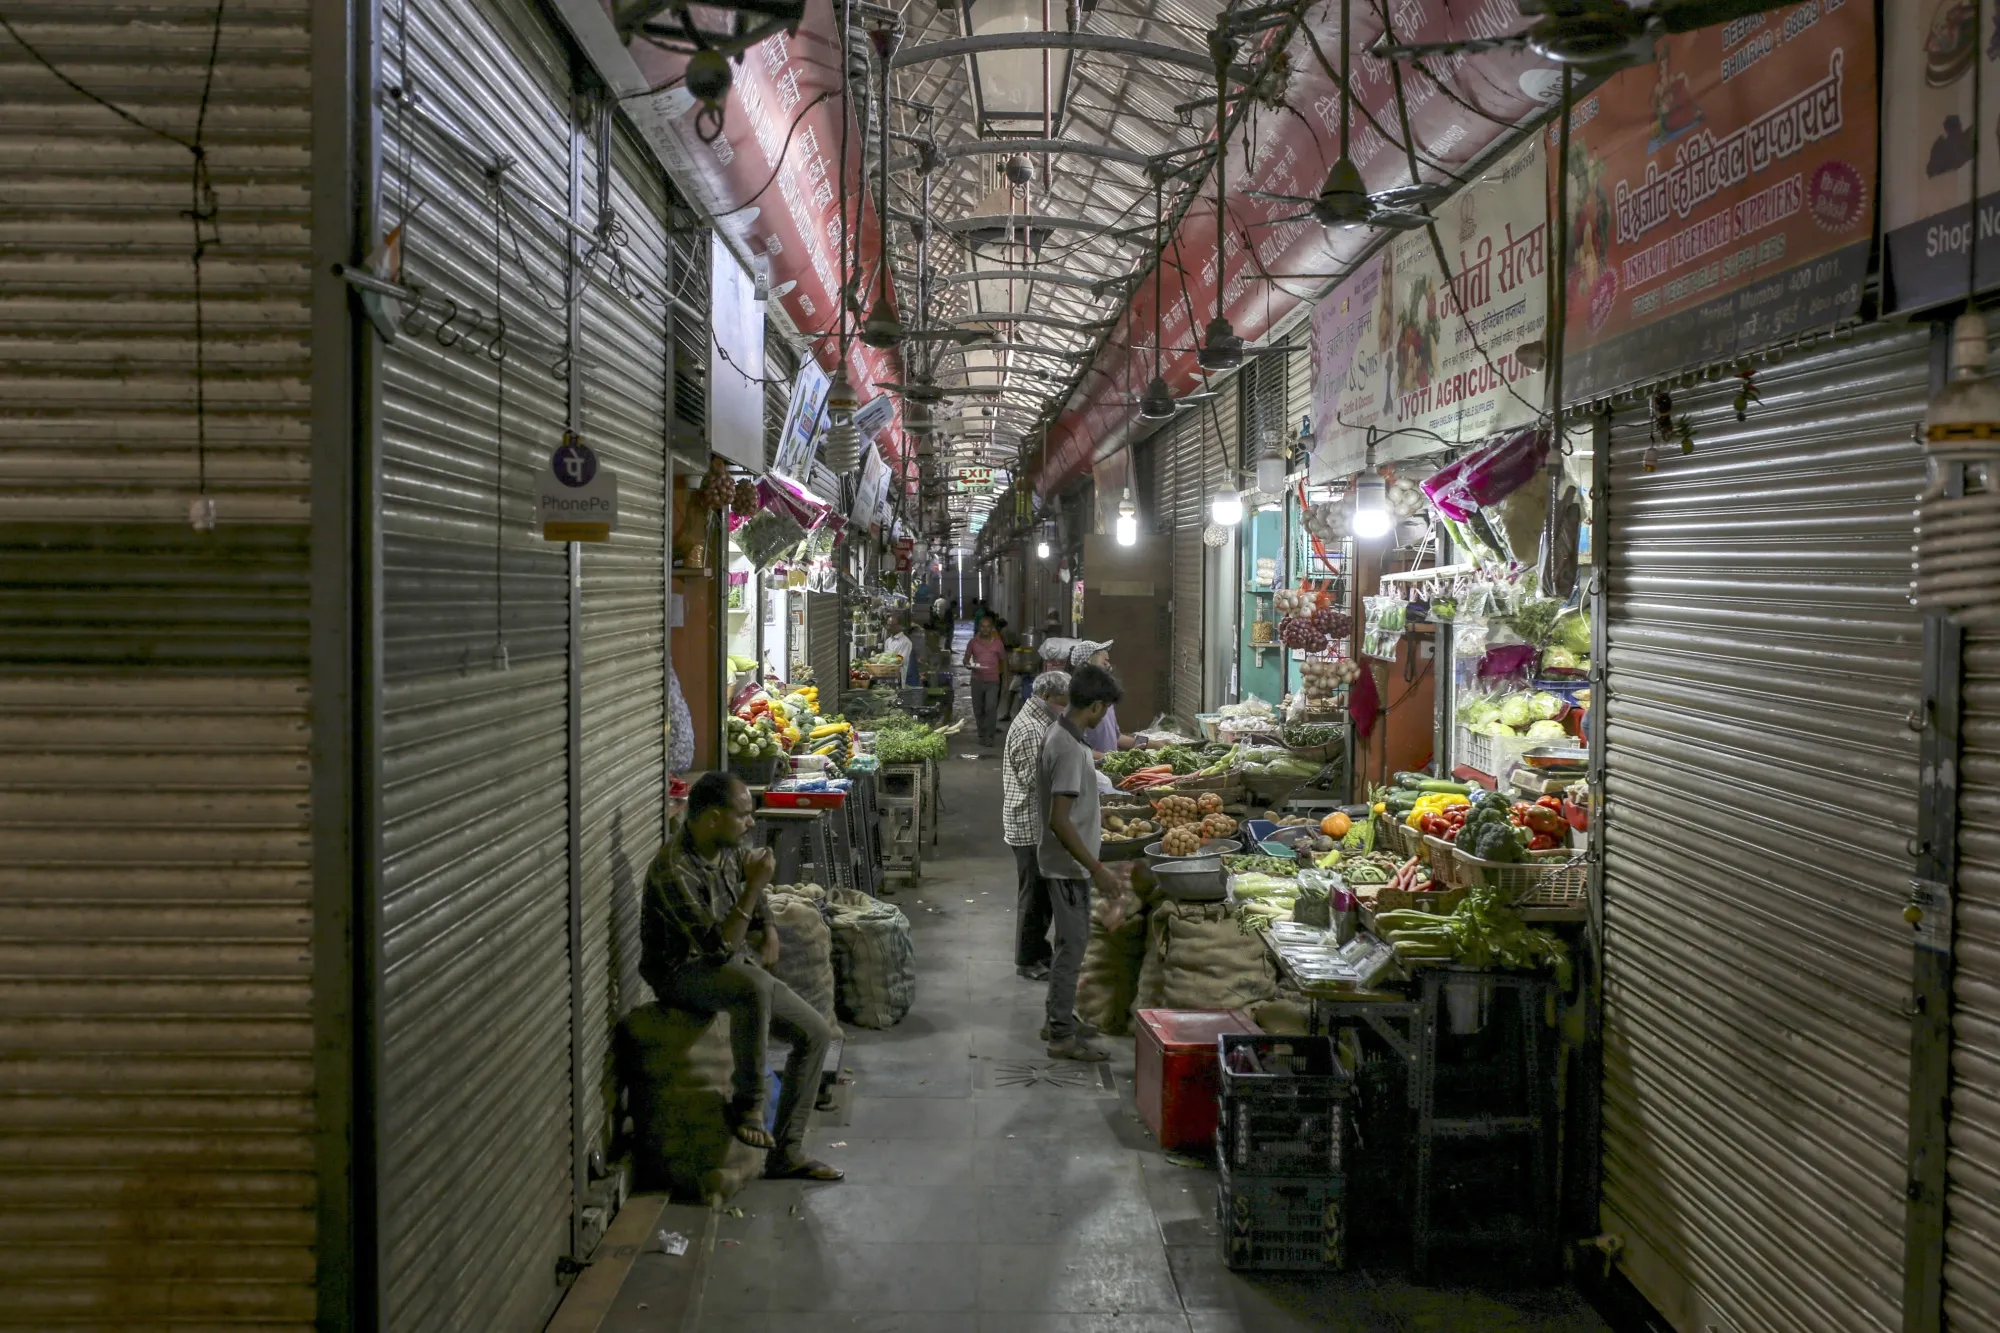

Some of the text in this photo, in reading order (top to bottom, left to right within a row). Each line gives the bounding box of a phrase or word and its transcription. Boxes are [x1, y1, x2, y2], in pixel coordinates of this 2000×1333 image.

[1722, 30, 1773, 83] BHIMRAO
[1784, 7, 1820, 42] 98929
[1671, 208, 1730, 266] VEGETABLE
[1733, 172, 1803, 239] SUPPLIERS
[1497, 222, 1545, 294] सेल्स
[1722, 232, 1787, 281] SUPPLIERS
[1926, 221, 1972, 258] Shop
[1788, 268, 1812, 292] 400
[1349, 356, 1357, 392] &
[1358, 350, 1379, 392] Sons
[1396, 386, 1432, 423] JYOTI
[563, 447, 585, 482] पे
[958, 469, 992, 478] EXIT
[542, 495, 610, 512] PhonePe
